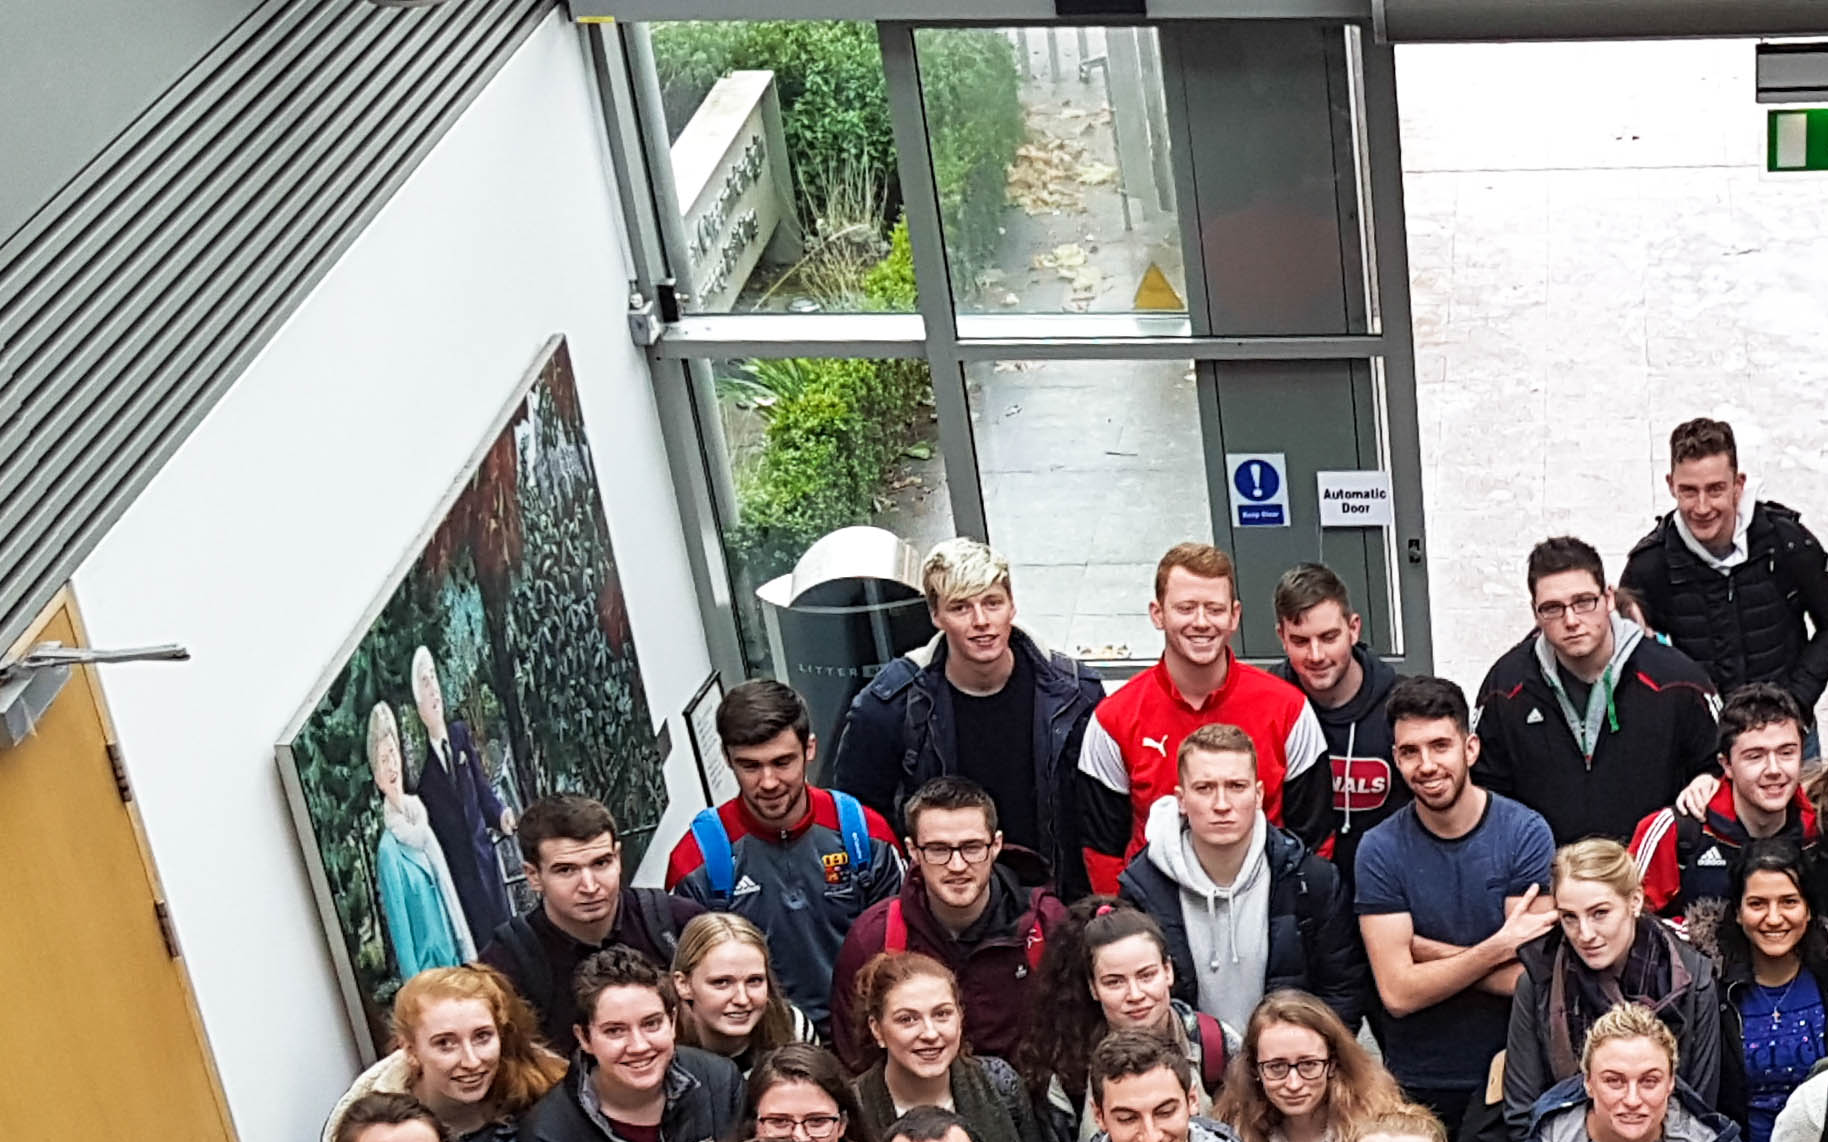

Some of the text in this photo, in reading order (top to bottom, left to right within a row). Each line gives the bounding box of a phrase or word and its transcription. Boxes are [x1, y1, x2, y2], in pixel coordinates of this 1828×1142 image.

[1323, 488, 1387, 500] Automatic
[1341, 503, 1370, 514] Door
[798, 663, 858, 678] LITTER
